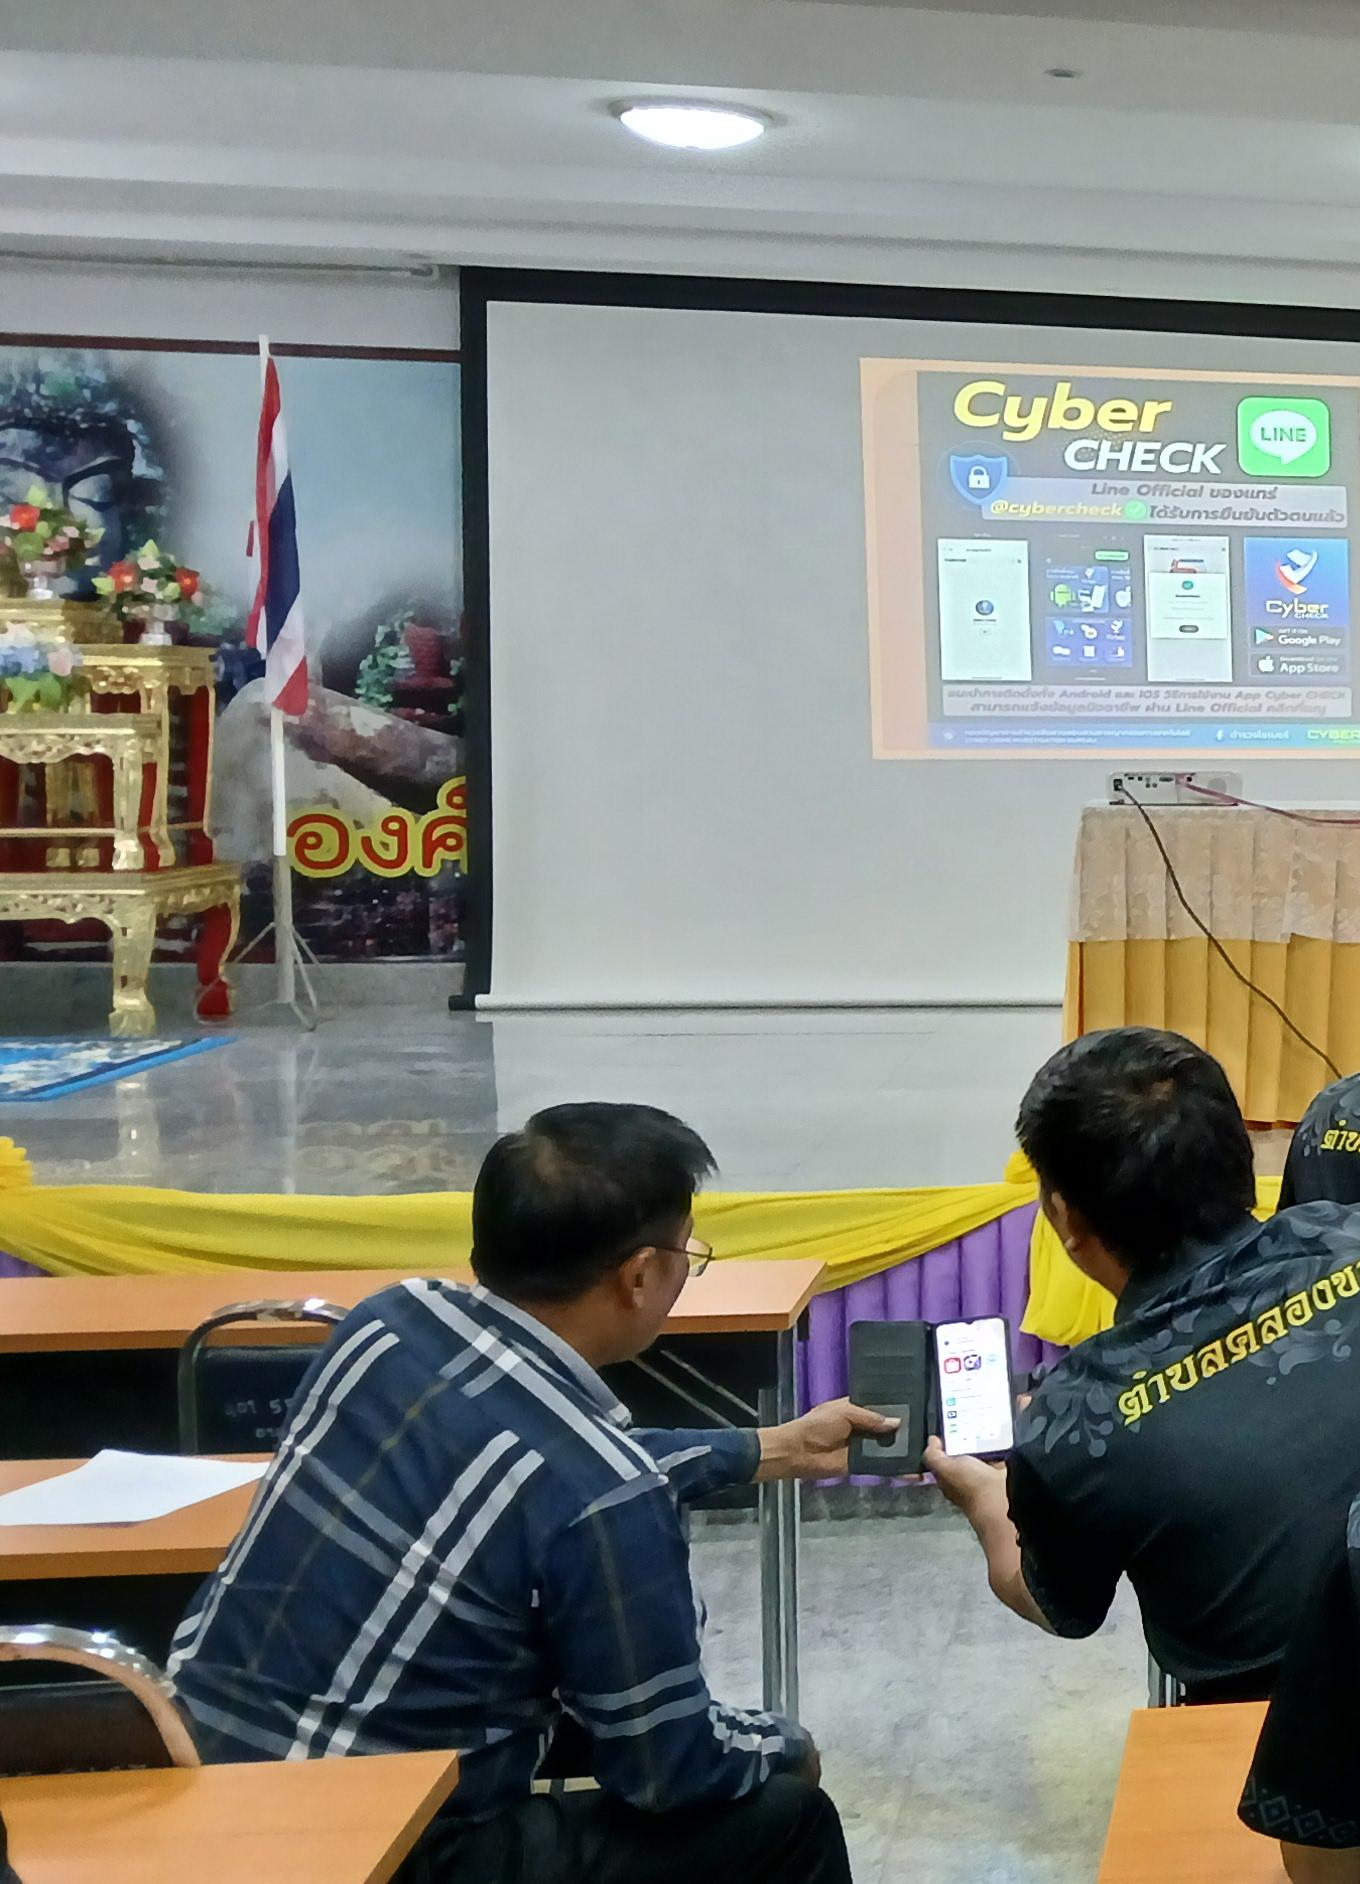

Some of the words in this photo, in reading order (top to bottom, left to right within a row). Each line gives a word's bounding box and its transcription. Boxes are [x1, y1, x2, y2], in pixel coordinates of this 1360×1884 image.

[953, 380, 1173, 442] Cyber
[1260, 427, 1307, 443] LINE
[1064, 438, 1227, 475] CHECK
[1091, 482, 1130, 497] Line
[1136, 483, 1203, 498] Official
[990, 500, 1122, 517] @cybercheck
[1265, 598, 1329, 618] Cyber
[1278, 634, 1317, 647] Google
[1319, 635, 1341, 646] Play
[1280, 662, 1305, 674] App
[1307, 663, 1339, 673] Store
[1060, 689, 1112, 700] Android
[1234, 690, 1261, 702] App
[1175, 703, 1206, 713] Line
[1209, 702, 1264, 714] Official
